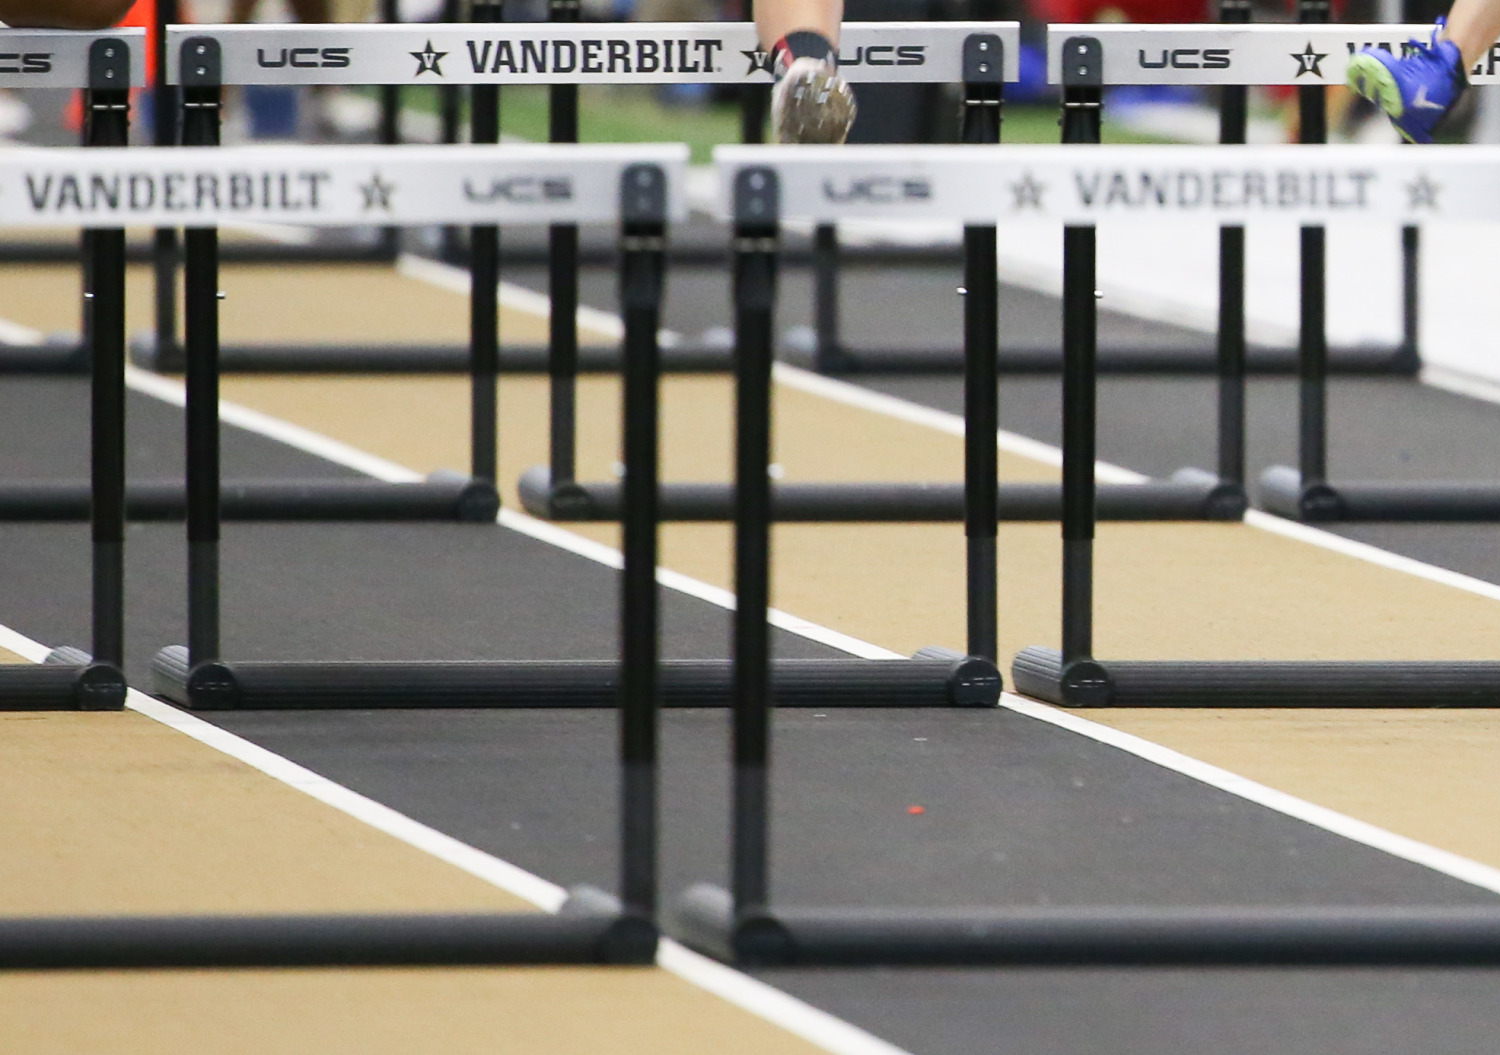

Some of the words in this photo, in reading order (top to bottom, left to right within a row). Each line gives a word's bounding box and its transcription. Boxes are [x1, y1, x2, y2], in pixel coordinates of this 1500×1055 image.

[0, 52, 52, 74] CS
[257, 48, 350, 69] UCS
[466, 39, 722, 74] VANDERBILT
[1138, 48, 1231, 70] UCS
[25, 171, 329, 212] VANDERBILT
[464, 176, 575, 204] UCS
[821, 177, 931, 205] UCS
[1073, 169, 1376, 210] VANDERBILT
